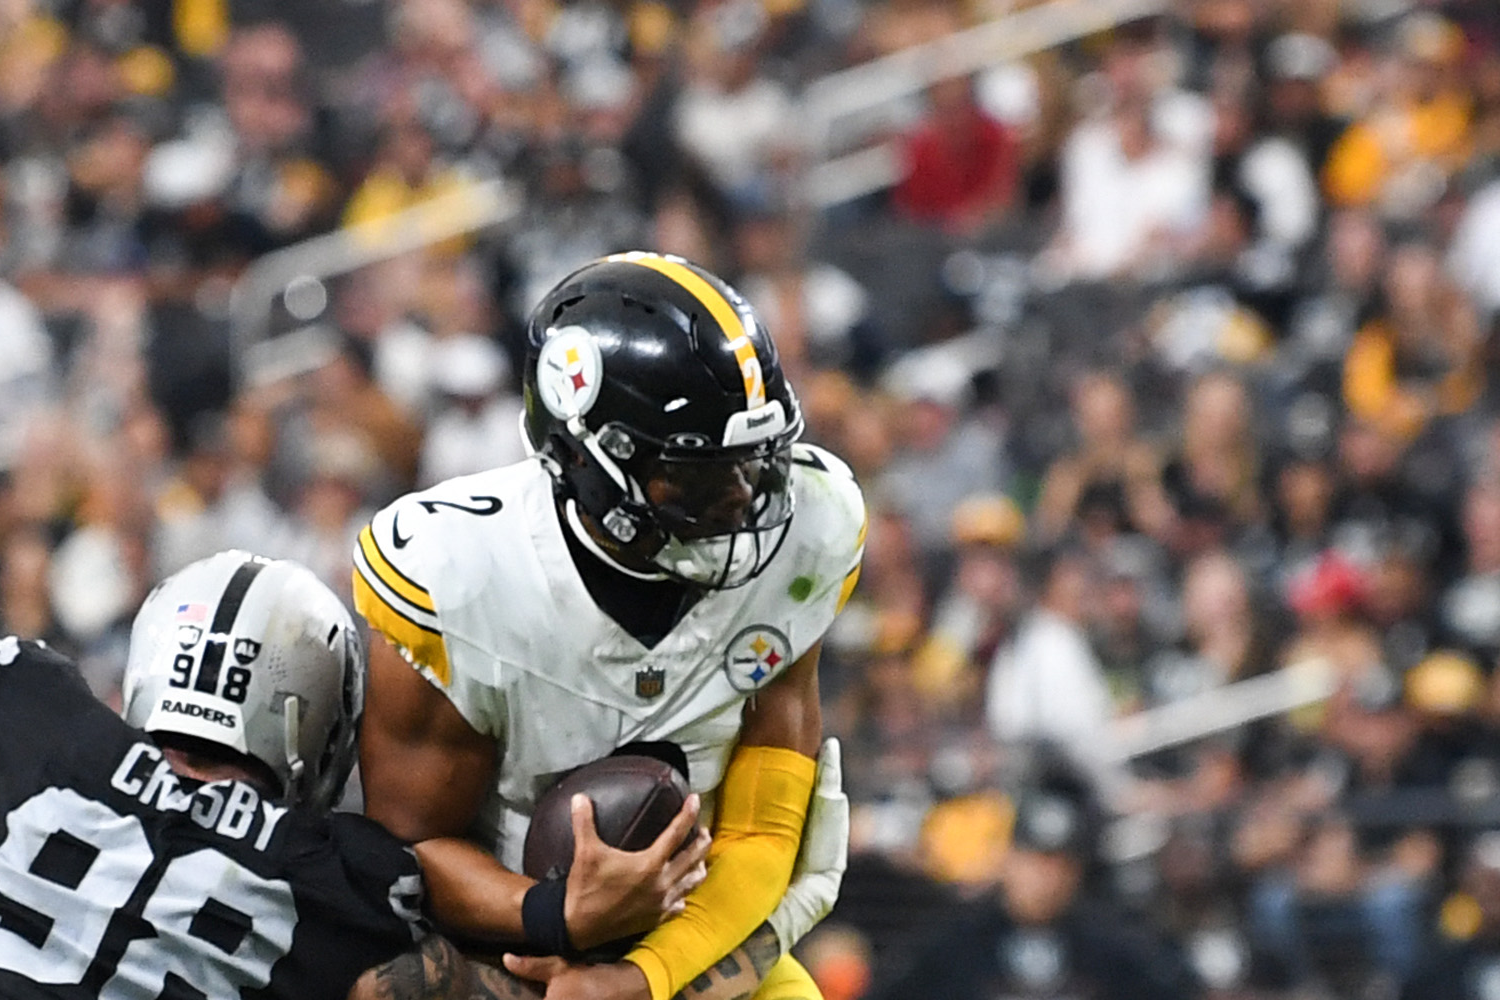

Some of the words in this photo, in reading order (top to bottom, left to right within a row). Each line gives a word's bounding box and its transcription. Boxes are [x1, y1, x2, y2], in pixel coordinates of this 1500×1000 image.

[743, 357, 765, 410] 2
[417, 495, 504, 516] 2
[160, 699, 237, 729] RAIDERS
